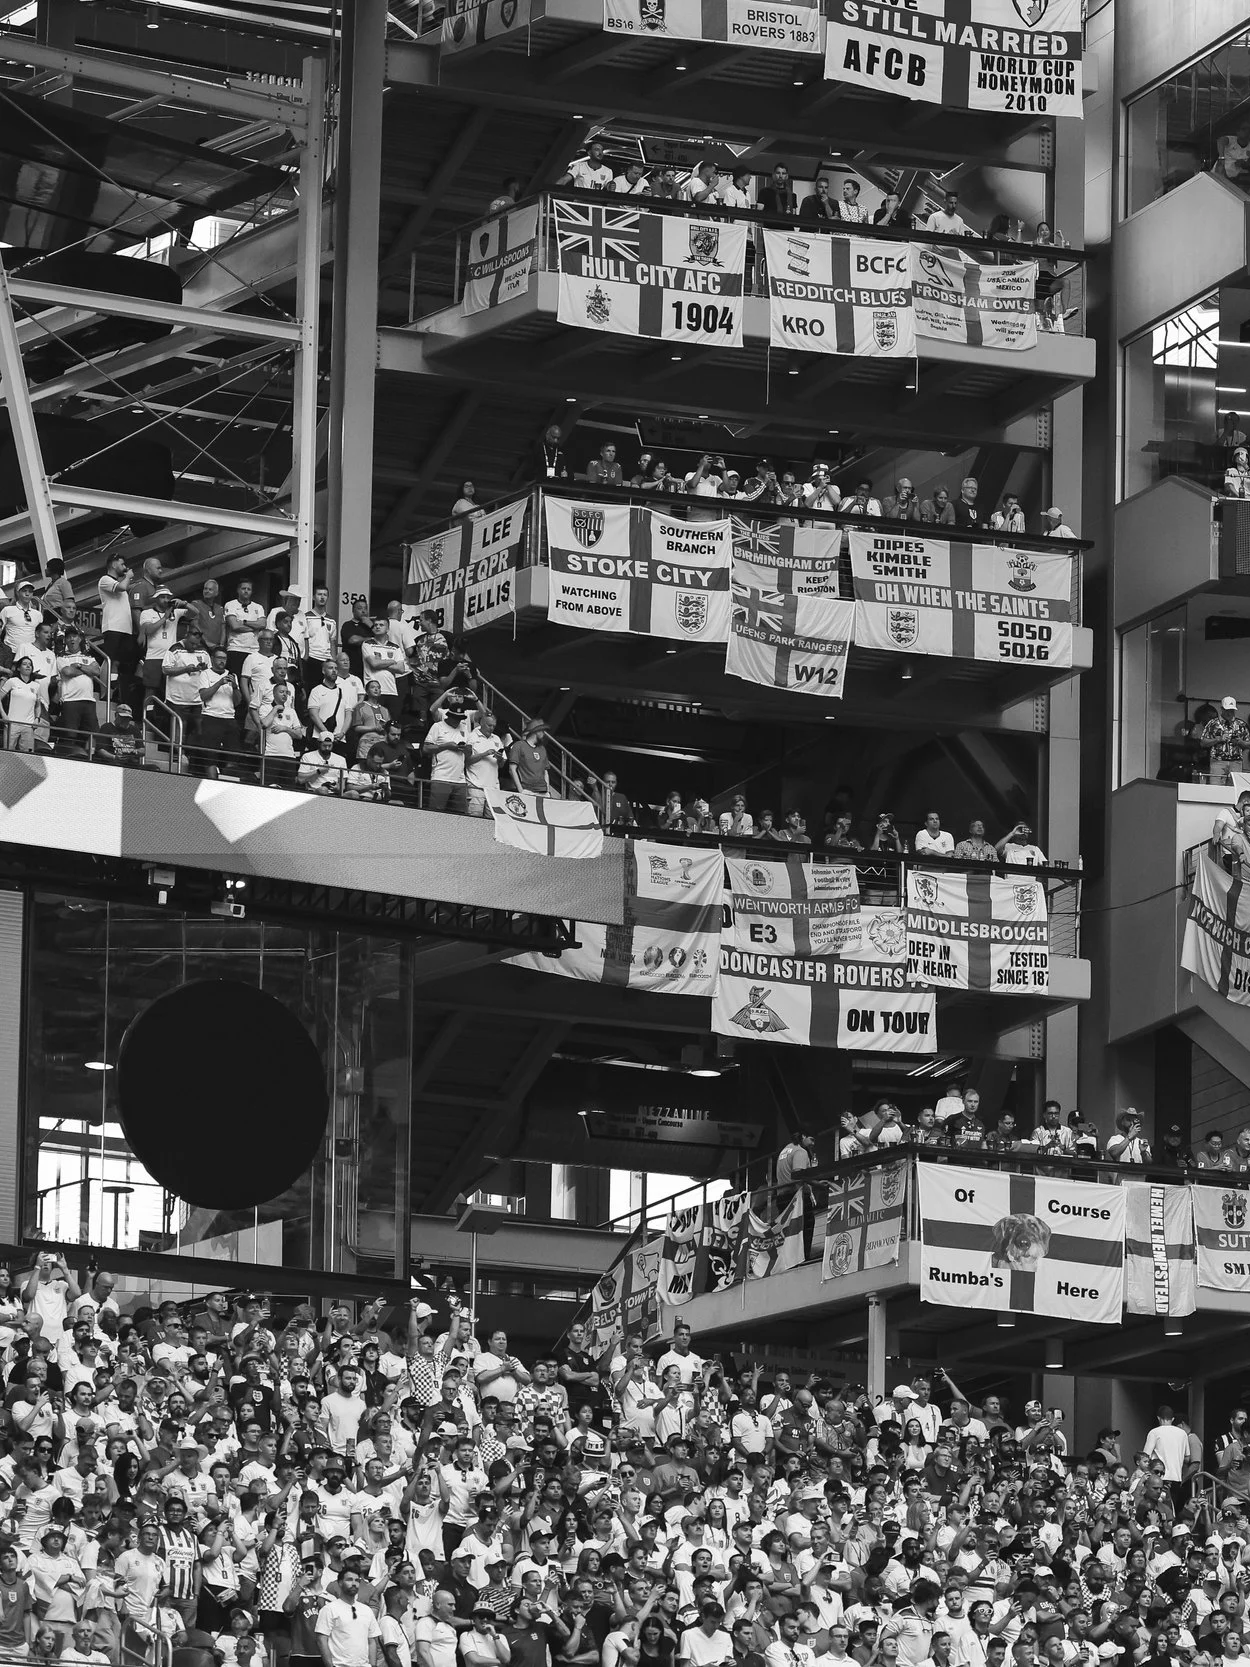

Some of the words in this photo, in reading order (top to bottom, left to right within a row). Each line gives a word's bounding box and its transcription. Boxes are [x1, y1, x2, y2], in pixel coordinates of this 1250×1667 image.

[607, 18, 634, 30] BS16
[747, 9, 803, 27] BRISTOL
[842, 0, 927, 39] STILL
[935, 20, 1069, 56] MARRIED
[732, 23, 786, 39] ROVERS
[789, 30, 815, 43] 1883
[843, 38, 927, 87] AFCB
[980, 54, 1038, 76] WORLD
[1042, 60, 1075, 78] CUP
[977, 73, 1075, 96] HONEYMOON
[1005, 93, 1048, 112] 2010
[581, 255, 631, 283] HULL
[635, 263, 678, 289] CITY
[683, 269, 721, 294] AFC
[856, 254, 907, 275] BCFC
[775, 281, 856, 303] REDDITCH
[860, 290, 907, 306] BLUES
[916, 285, 988, 310] FRODSHAM
[992, 299, 1031, 312] OWLS
[671, 300, 734, 335] 1904
[782, 314, 825, 337] KRO
[482, 515, 512, 548] LEE
[659, 525, 724, 541] SOUTHERN
[752, 532, 770, 541] BLUES
[666, 541, 716, 555] BRANCH
[873, 538, 925, 554] DIPES
[733, 546, 812, 571] BIRMINGHAM
[866, 551, 932, 567] KIMBLE
[419, 576, 442, 603] WE
[443, 564, 475, 595] ARE
[477, 549, 509, 581] QPR
[567, 554, 649, 579] STOKE
[656, 564, 713, 587] CITY
[805, 575, 829, 584] KEEP
[872, 564, 927, 579] SMITH
[466, 580, 511, 617] ELLIS
[561, 584, 617, 600] WATCHING
[874, 582, 900, 602] OH
[902, 584, 952, 608] WHEN
[955, 590, 987, 612] THE
[990, 594, 1050, 619] SAINTS
[555, 599, 584, 613] FROM
[586, 604, 622, 617] ABOVE
[735, 624, 767, 640] UEENS
[769, 633, 796, 647] PARK
[797, 640, 844, 653] RANGERS
[794, 663, 839, 685] W12
[734, 898, 811, 914] WENTWORTH
[813, 901, 845, 914] ARMS
[845, 898, 858, 910] FC
[749, 923, 778, 944] E3
[822, 929, 834, 937] AND
[907, 914, 1048, 941] MIDDLESBROUGH
[1191, 899, 1241, 951] NORWICH
[908, 940, 936, 958] DEEP
[939, 945, 951, 961] IN
[1009, 951, 1048, 969] TESTED
[719, 950, 827, 983] DONCASTER
[833, 964, 905, 988] ROVERS
[923, 960, 958, 980] HEART
[996, 969, 1029, 986] SINCE
[846, 1008, 875, 1033] ON
[879, 1011, 930, 1035] TOUR
[954, 1188, 975, 1203] Of
[1047, 1199, 1111, 1221] Course
[1151, 1187, 1165, 1232] HEMEL
[928, 1266, 1004, 1288] Rumba's
[1056, 1280, 1100, 1300] Here
[1152, 1234, 1169, 1313] HEMPSTEAD
